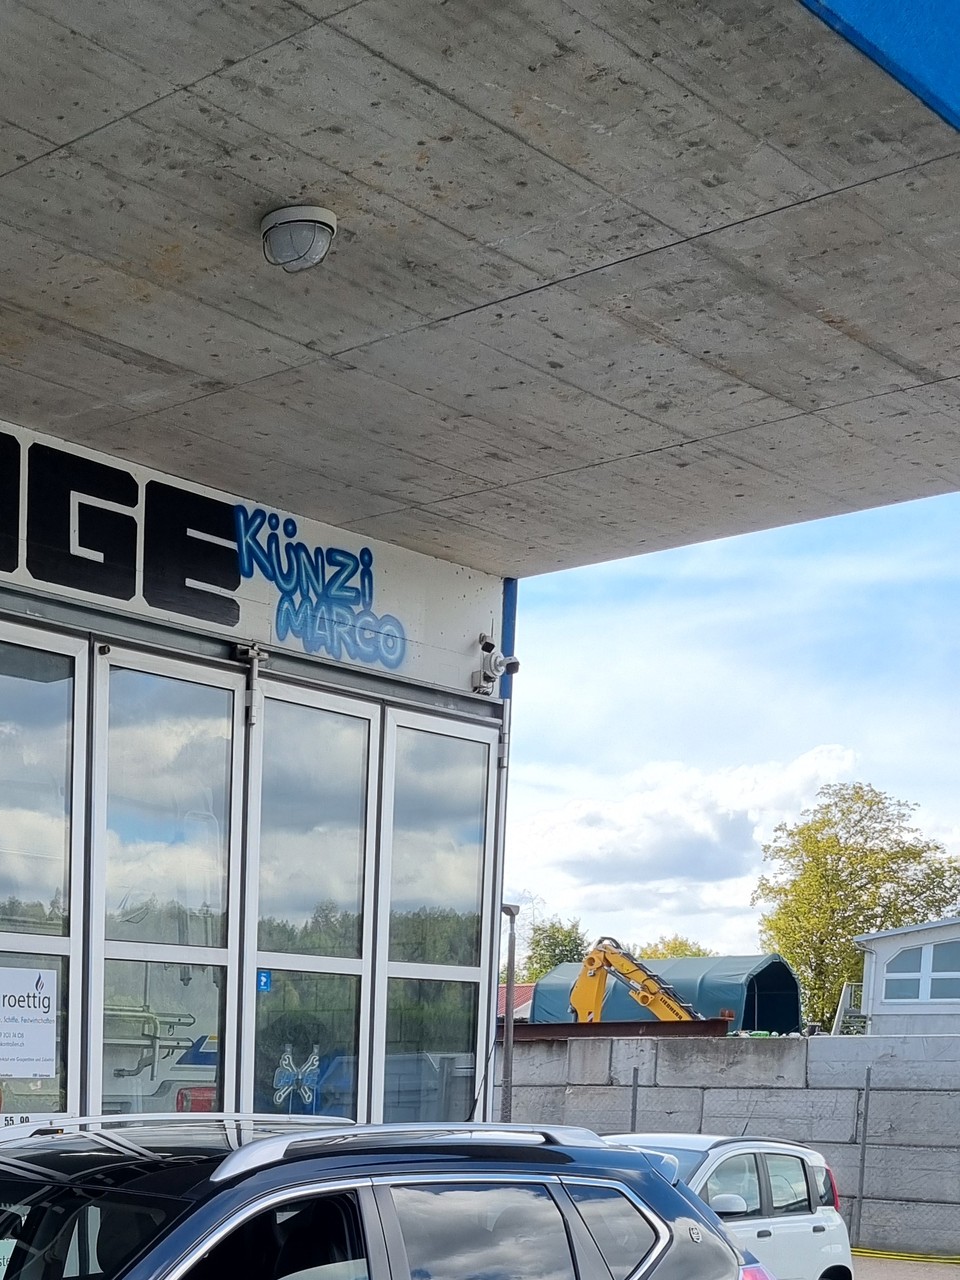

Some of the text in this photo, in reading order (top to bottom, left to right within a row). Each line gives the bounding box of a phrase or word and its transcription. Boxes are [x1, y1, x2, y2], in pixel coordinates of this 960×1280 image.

[276, 592, 406, 670] MARCO
[2, 991, 51, 1014] roettig
[4, 1116, 14, 1126] 55
